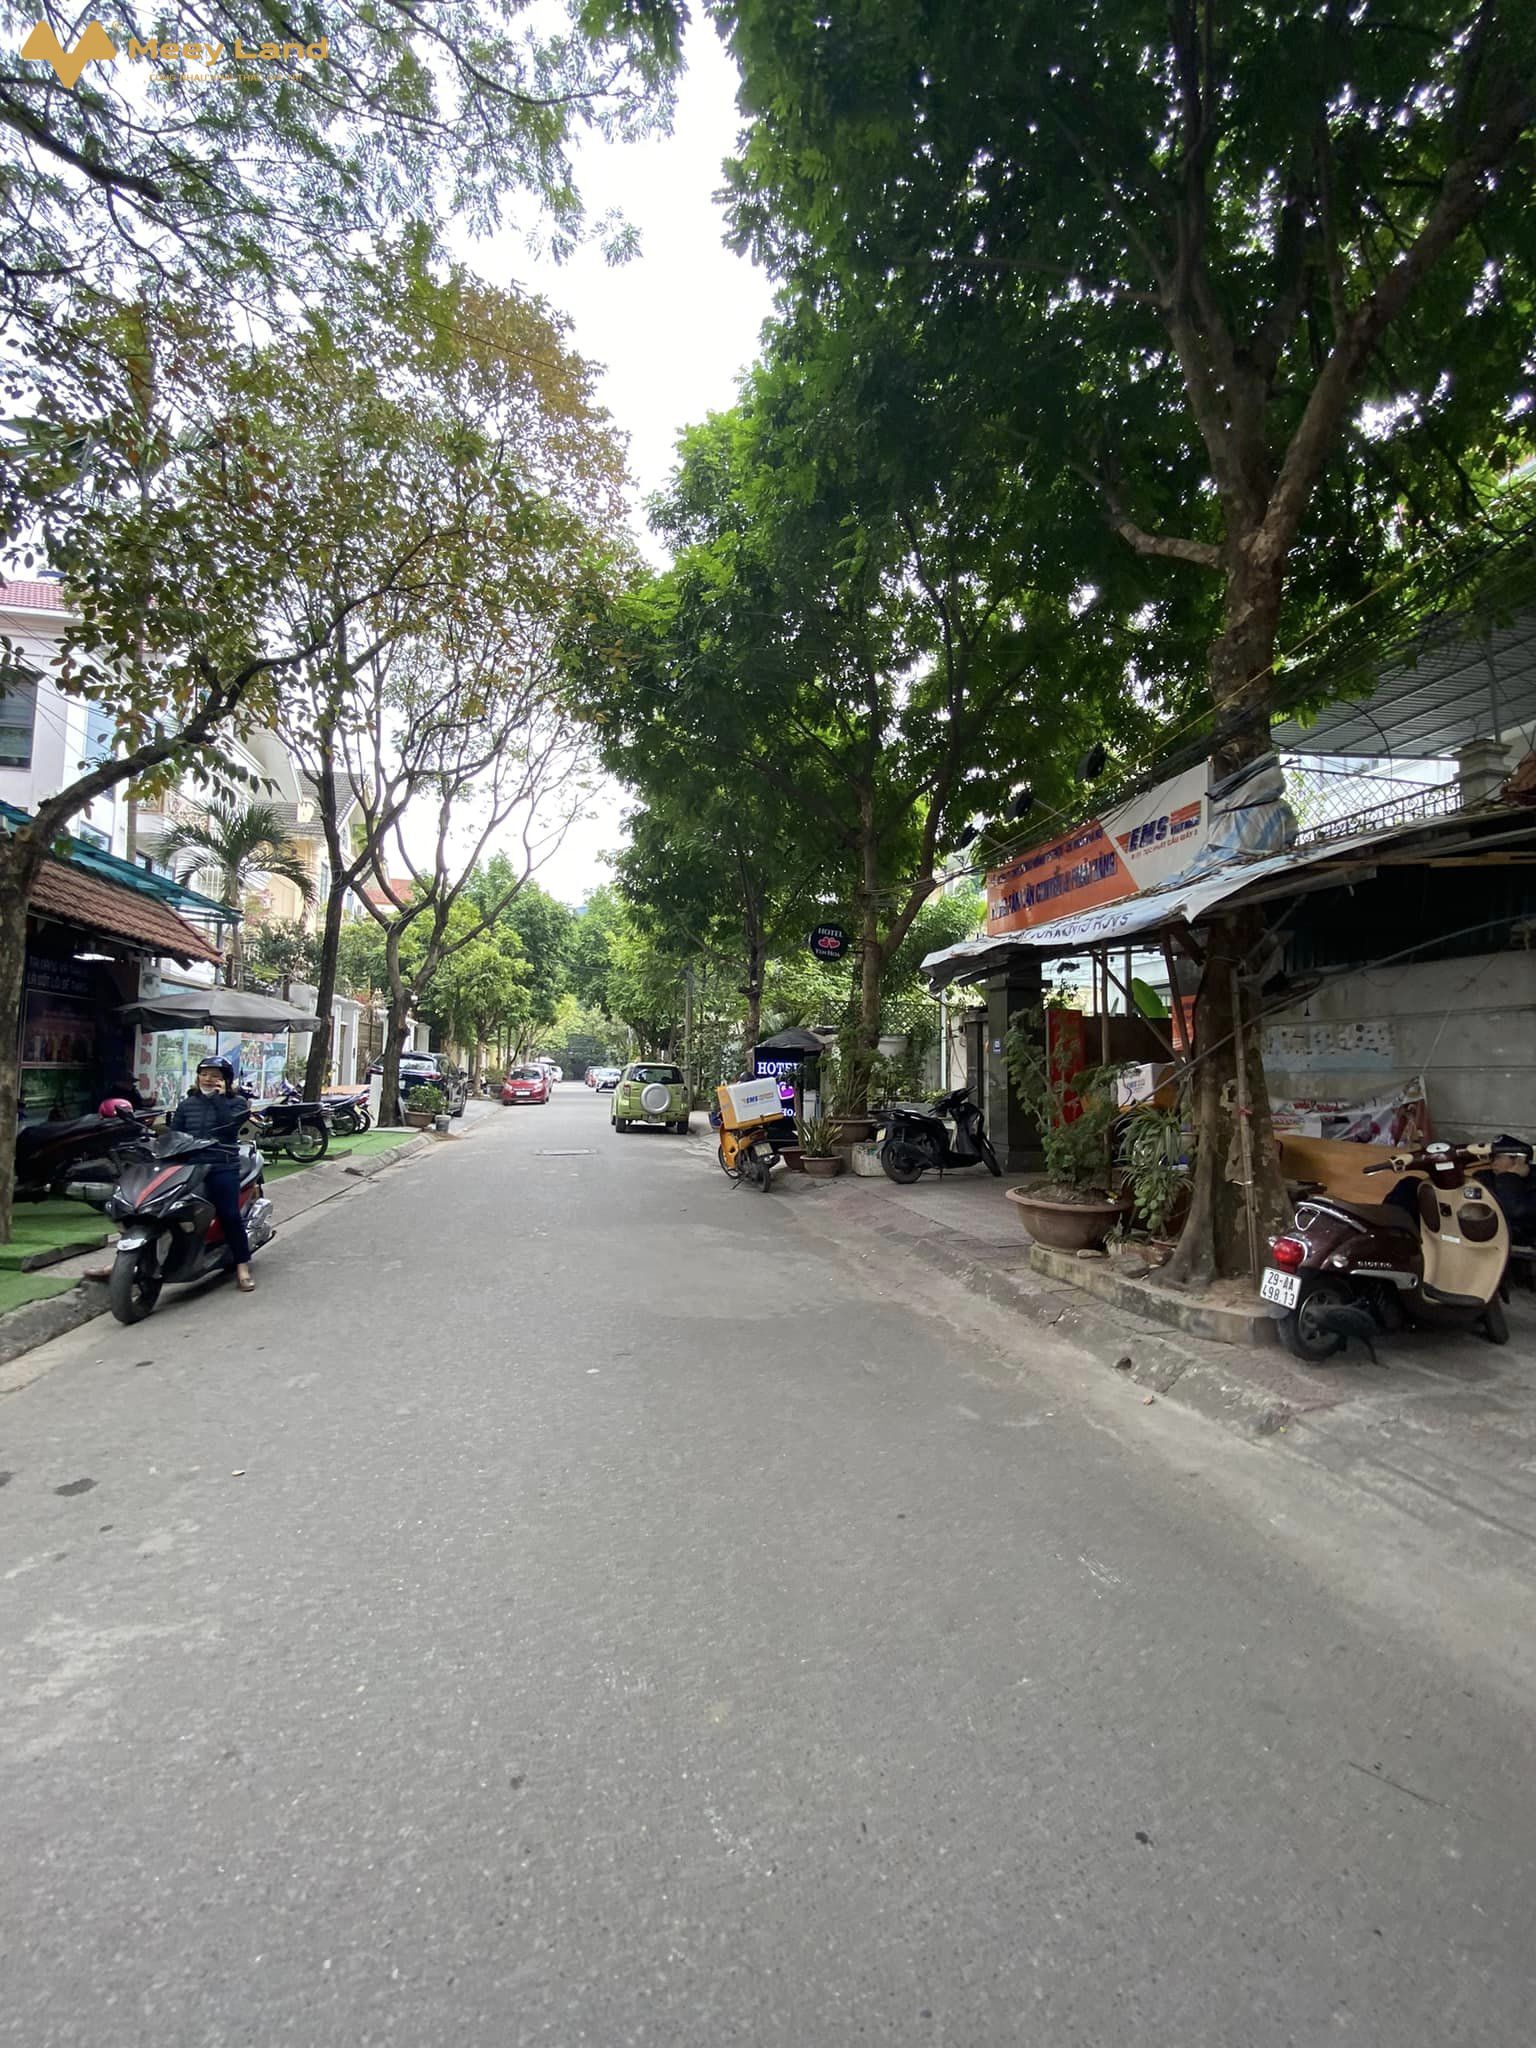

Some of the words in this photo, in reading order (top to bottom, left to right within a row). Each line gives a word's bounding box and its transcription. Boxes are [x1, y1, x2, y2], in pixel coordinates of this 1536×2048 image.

[1129, 816, 1169, 852] EMS
[818, 927, 843, 938] HOTEL
[1267, 1271, 1295, 1292] 29-AA
